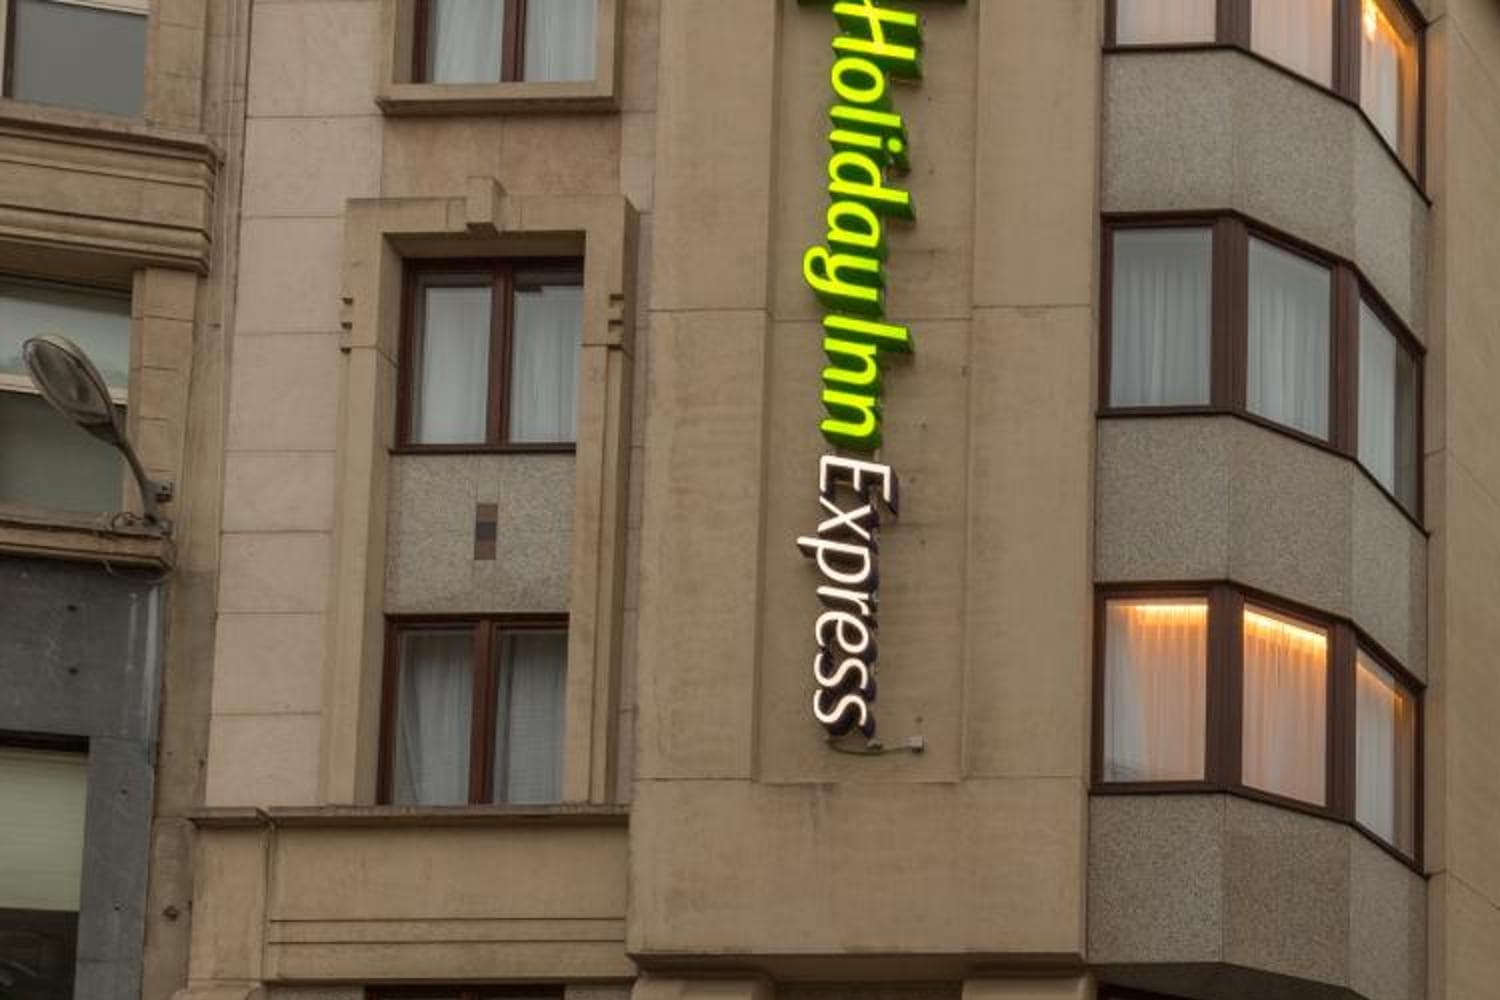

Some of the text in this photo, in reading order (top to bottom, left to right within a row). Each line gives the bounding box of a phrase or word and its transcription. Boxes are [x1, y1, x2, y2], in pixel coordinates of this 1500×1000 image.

[797, 0, 918, 729] Holiday Inn Express
